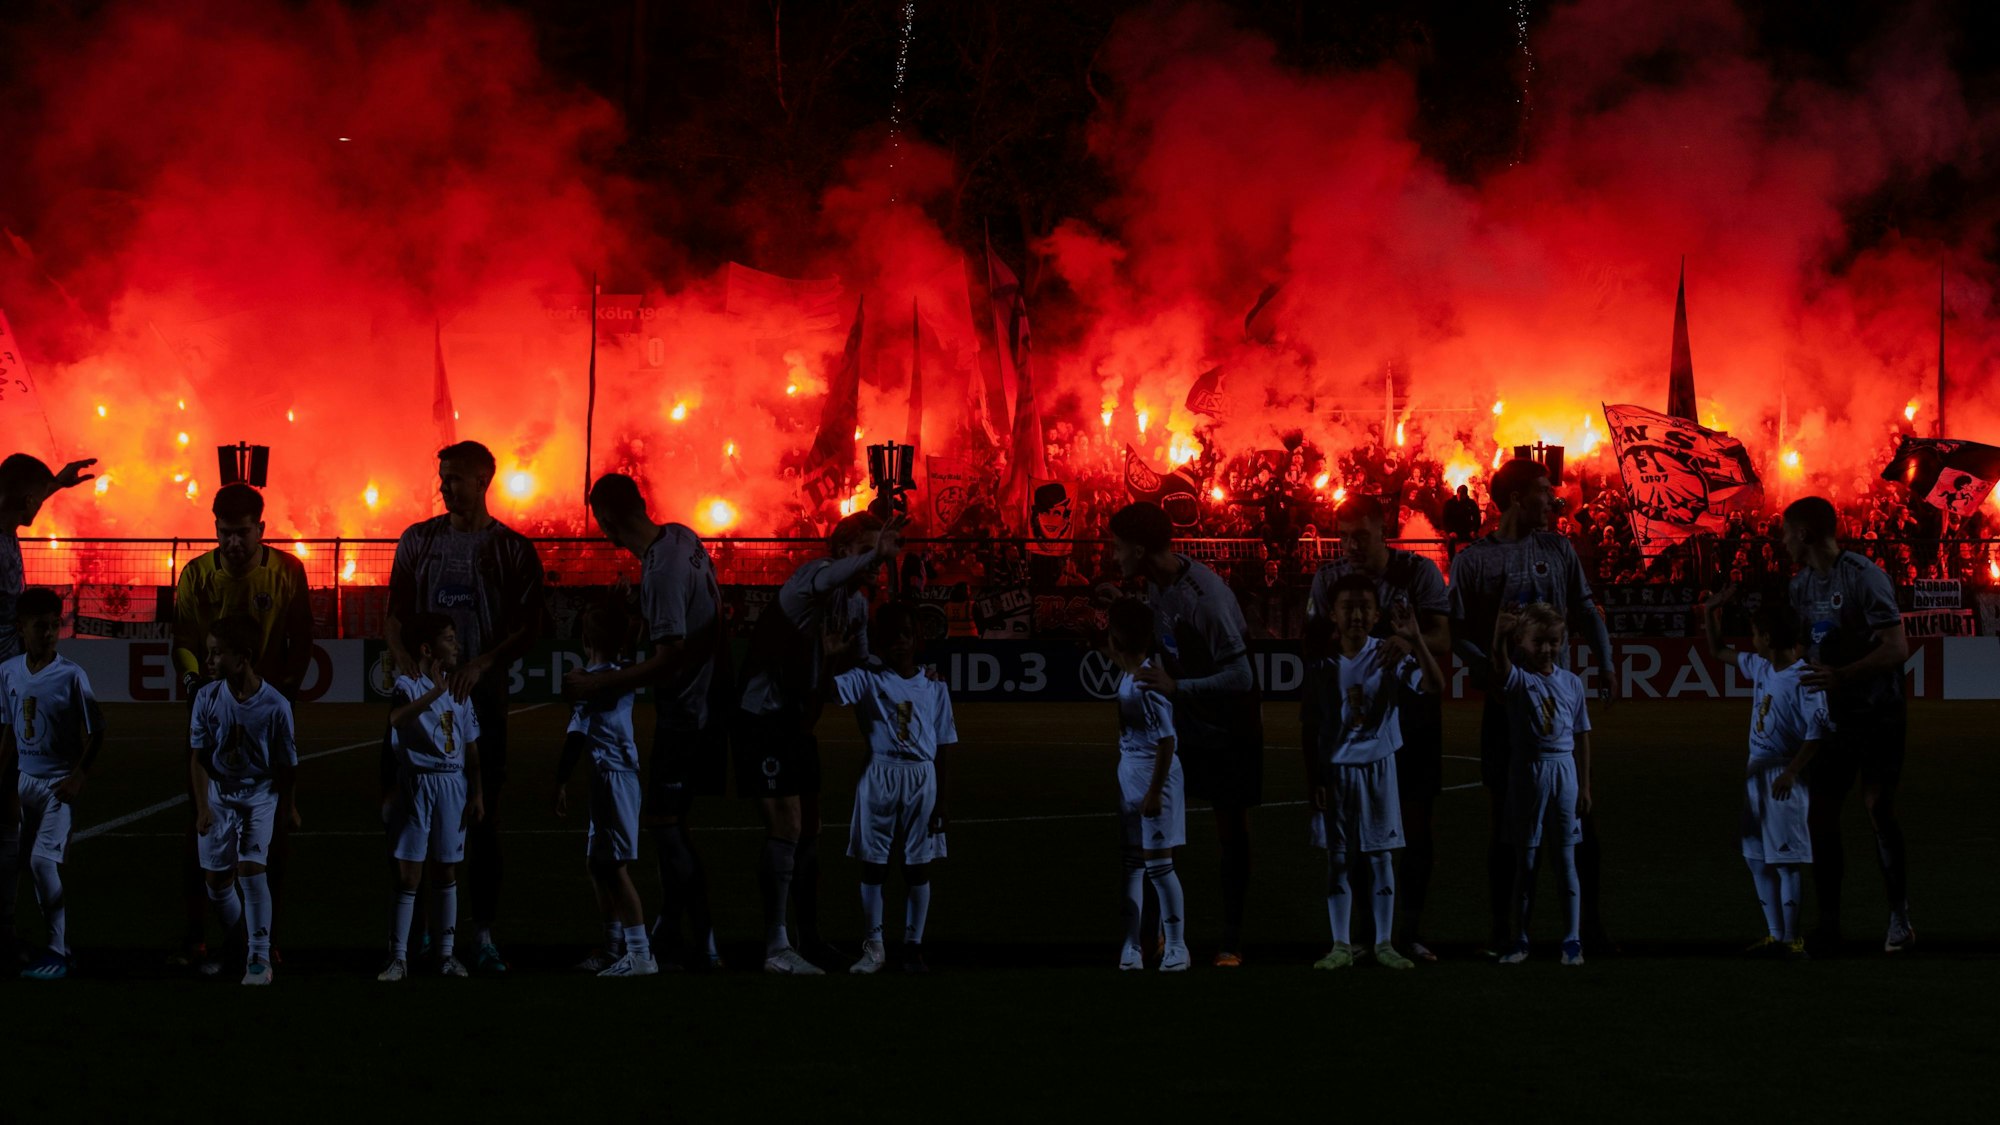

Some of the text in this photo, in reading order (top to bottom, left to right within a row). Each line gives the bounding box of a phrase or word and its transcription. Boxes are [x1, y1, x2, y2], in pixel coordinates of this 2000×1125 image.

[595, 305, 634, 320] Köln
[1915, 580, 1959, 592] SLOBODA
[1604, 587, 1694, 605] LTRAS
[76, 617, 113, 637] SGE
[1614, 613, 1686, 632] EVER
[1904, 611, 1975, 636] NKFURT
[951, 652, 1048, 692] ID.3
[1254, 652, 1304, 692] ID
